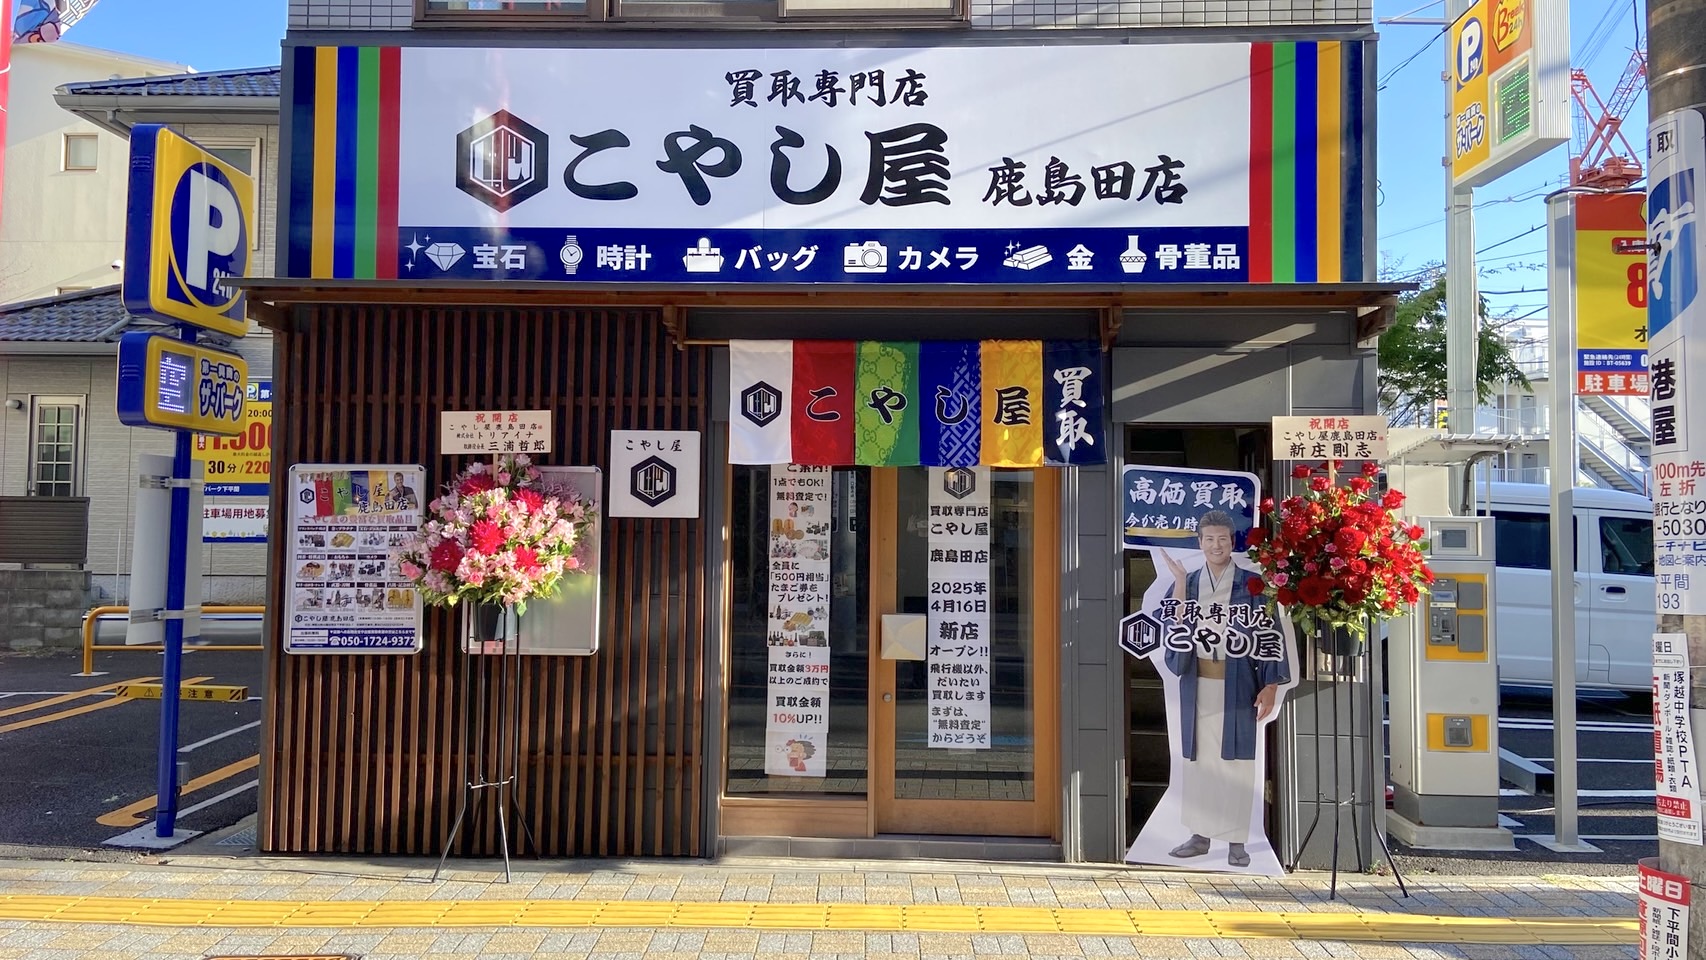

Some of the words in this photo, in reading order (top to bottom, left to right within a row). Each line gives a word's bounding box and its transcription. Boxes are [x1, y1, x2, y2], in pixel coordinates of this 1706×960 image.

[1461, 21, 1481, 80] P
[725, 69, 927, 108] 買取専門店
[565, 125, 951, 206] こやし屋
[982, 155, 1189, 206] 鹿島田店
[186, 169, 240, 291] P
[472, 243, 528, 272] 宝石
[596, 243, 652, 272] 時計
[735, 246, 820, 272] バッグ
[898, 247, 981, 272] カメラ
[1066, 245, 1096, 272] 金
[1156, 245, 1242, 272] 骨董品
[1581, 374, 1649, 392] 駐車場
[805, 384, 1032, 425] こやし屋
[1053, 366, 1095, 458] 買取
[475, 413, 518, 423] 祝開店
[1310, 418, 1349, 430] 祝開店
[626, 440, 682, 452] こやし屋
[1290, 442, 1372, 458] 新庄剛志
[1130, 476, 1248, 510] 高価買取
[1660, 479, 1696, 496] 左折
[203, 508, 269, 519] 車場用地募
[930, 505, 988, 517] 買取専門店
[930, 522, 989, 536] こやし屋
[1125, 512, 1198, 532] 今が売り時
[1654, 541, 1706, 552] ーチナビ
[930, 549, 988, 564] 鹿島田店
[931, 582, 986, 595] 2025年
[1655, 574, 1689, 591] 平間
[931, 600, 987, 613] 4月16日
[1160, 599, 1274, 629] 買取専門店
[940, 621, 979, 640] 新店
[341, 637, 415, 646] 050-1724-9372
[1166, 627, 1282, 660] こやし屋
[937, 676, 980, 687] だいたい
[932, 690, 986, 701] 買取します
[932, 733, 986, 744] からどうぞ
[1667, 907, 1680, 960] 下平間小
